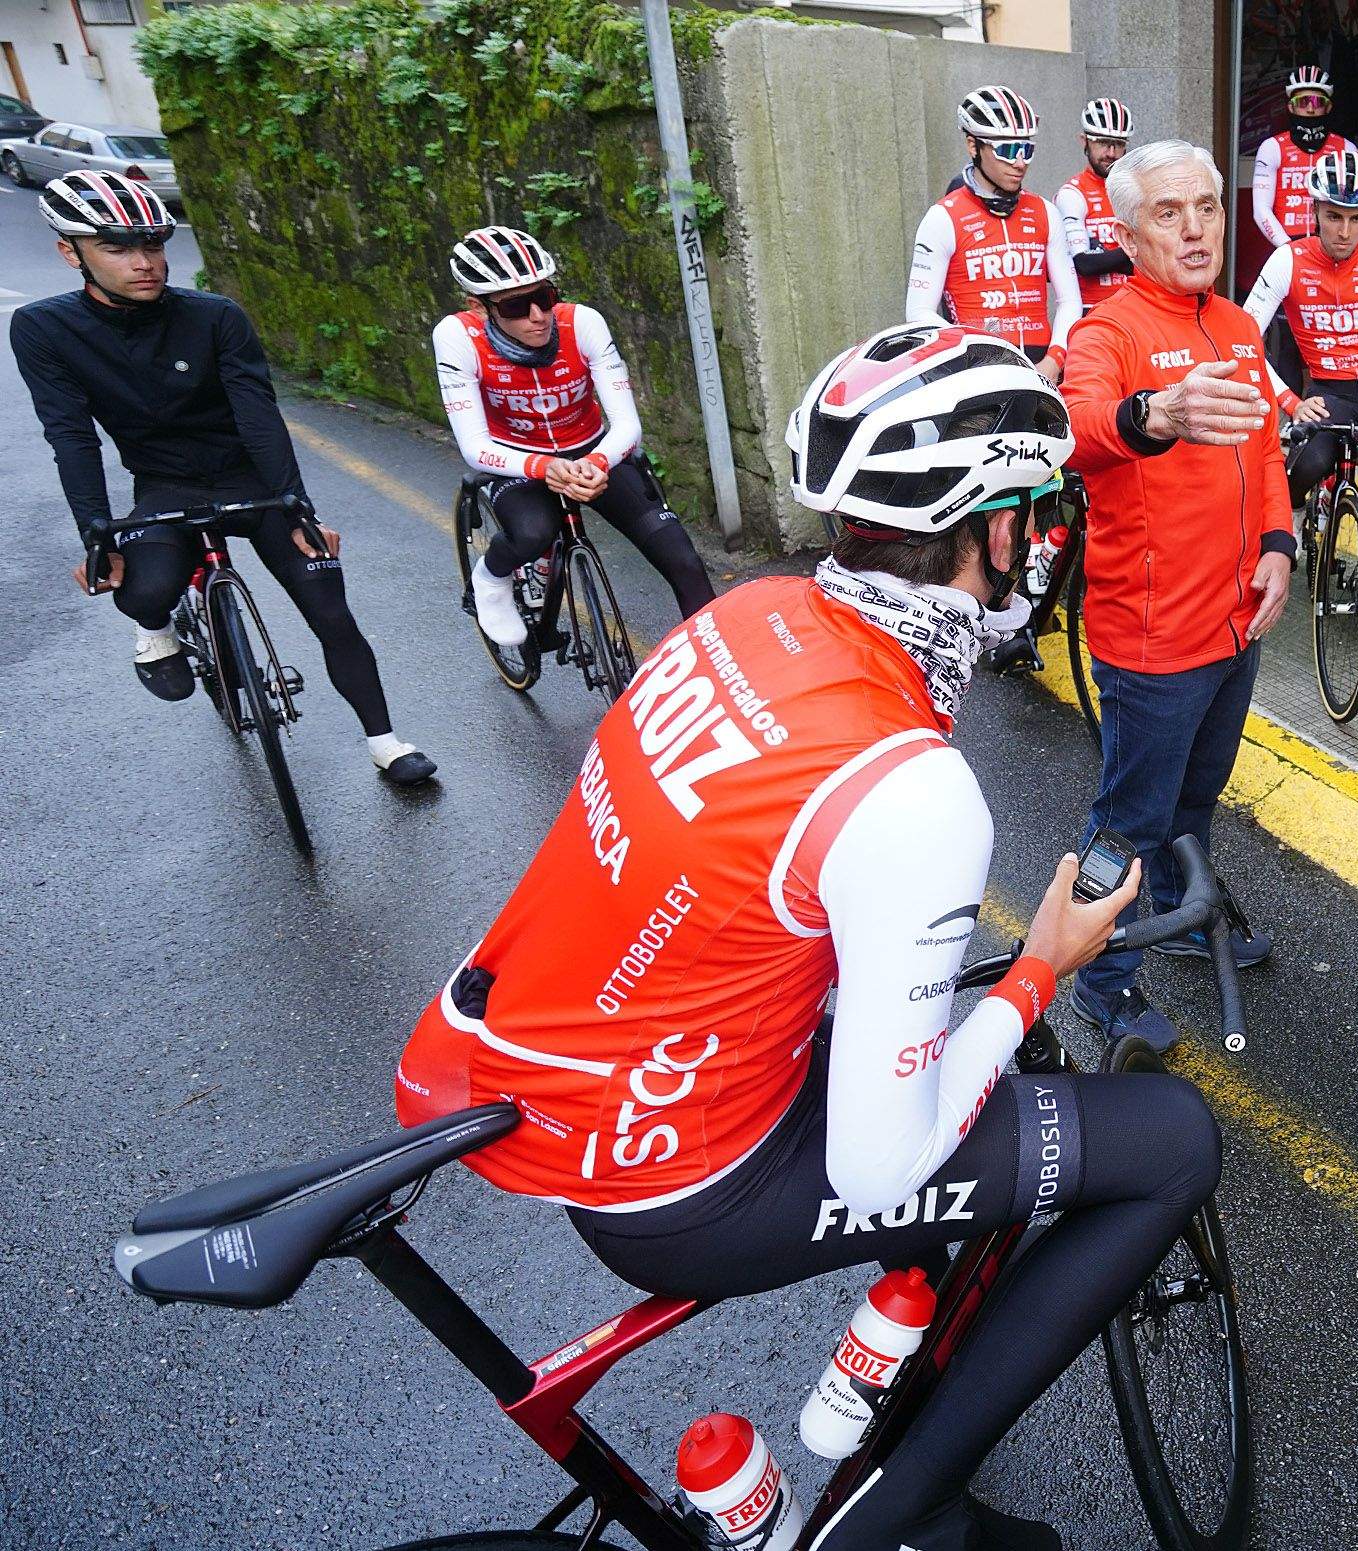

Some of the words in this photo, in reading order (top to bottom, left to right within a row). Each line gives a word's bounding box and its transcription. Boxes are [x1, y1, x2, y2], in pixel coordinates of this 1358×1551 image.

[965, 242, 1045, 257] supermercados
[965, 251, 1045, 281] FROIZ
[1150, 349, 1195, 370] FROIZ
[487, 375, 587, 396] supermercados
[487, 382, 588, 415] FROIZ
[478, 451, 507, 469] FROIZ
[983, 439, 1053, 468] Spiuk
[696, 612, 789, 746] supermercados
[628, 629, 762, 823] FROIZ
[596, 875, 699, 1016] OTTOBOSLEY
[525, 1111, 539, 1124] San
[841, 1336, 890, 1382] FROIZ
[827, 1380, 858, 1405] Pasión
[830, 1403, 869, 1423] ciclismo
[726, 1469, 781, 1527] FROIZ
